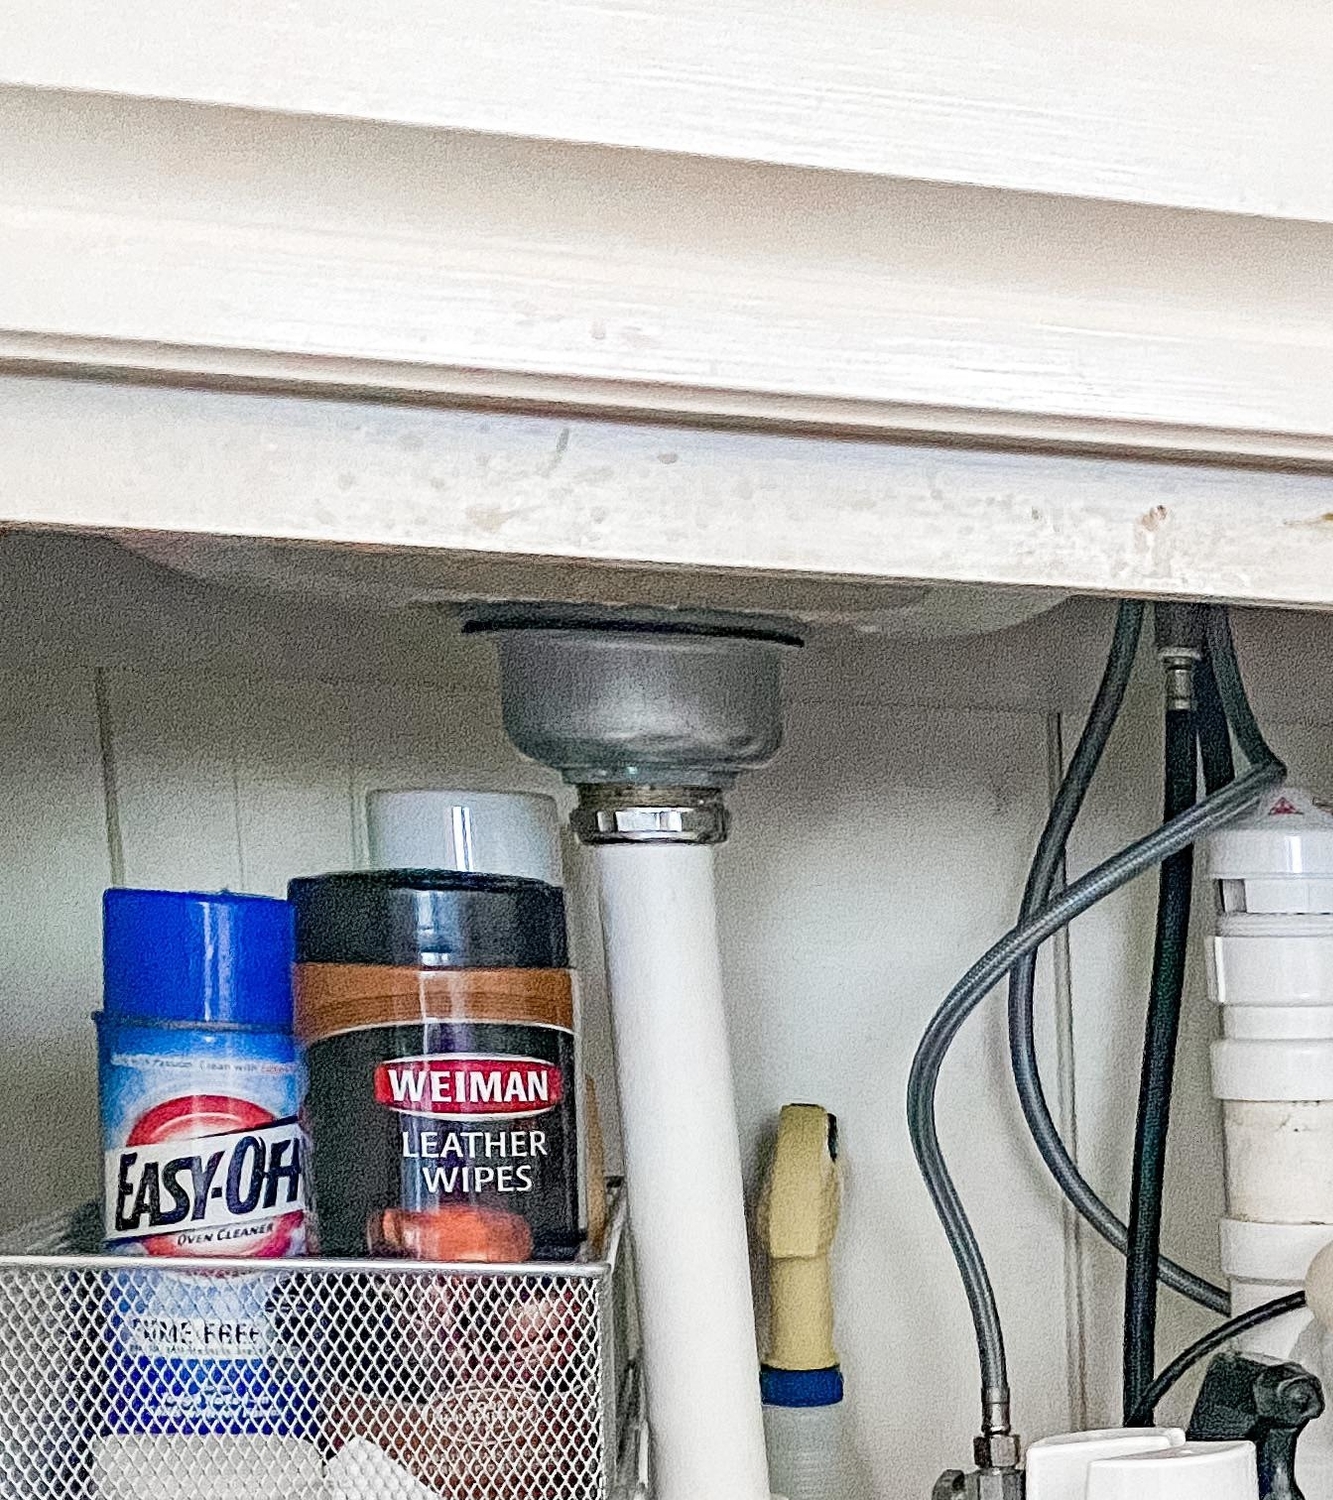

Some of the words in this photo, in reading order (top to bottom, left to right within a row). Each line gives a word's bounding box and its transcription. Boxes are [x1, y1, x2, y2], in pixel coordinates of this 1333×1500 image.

[388, 1069, 548, 1103] WEIMAN
[402, 1131, 548, 1158] LEATHER
[422, 1165, 533, 1193] WIPES
[177, 1230, 213, 1246] OVEN
[217, 1223, 274, 1241] CLEANER
